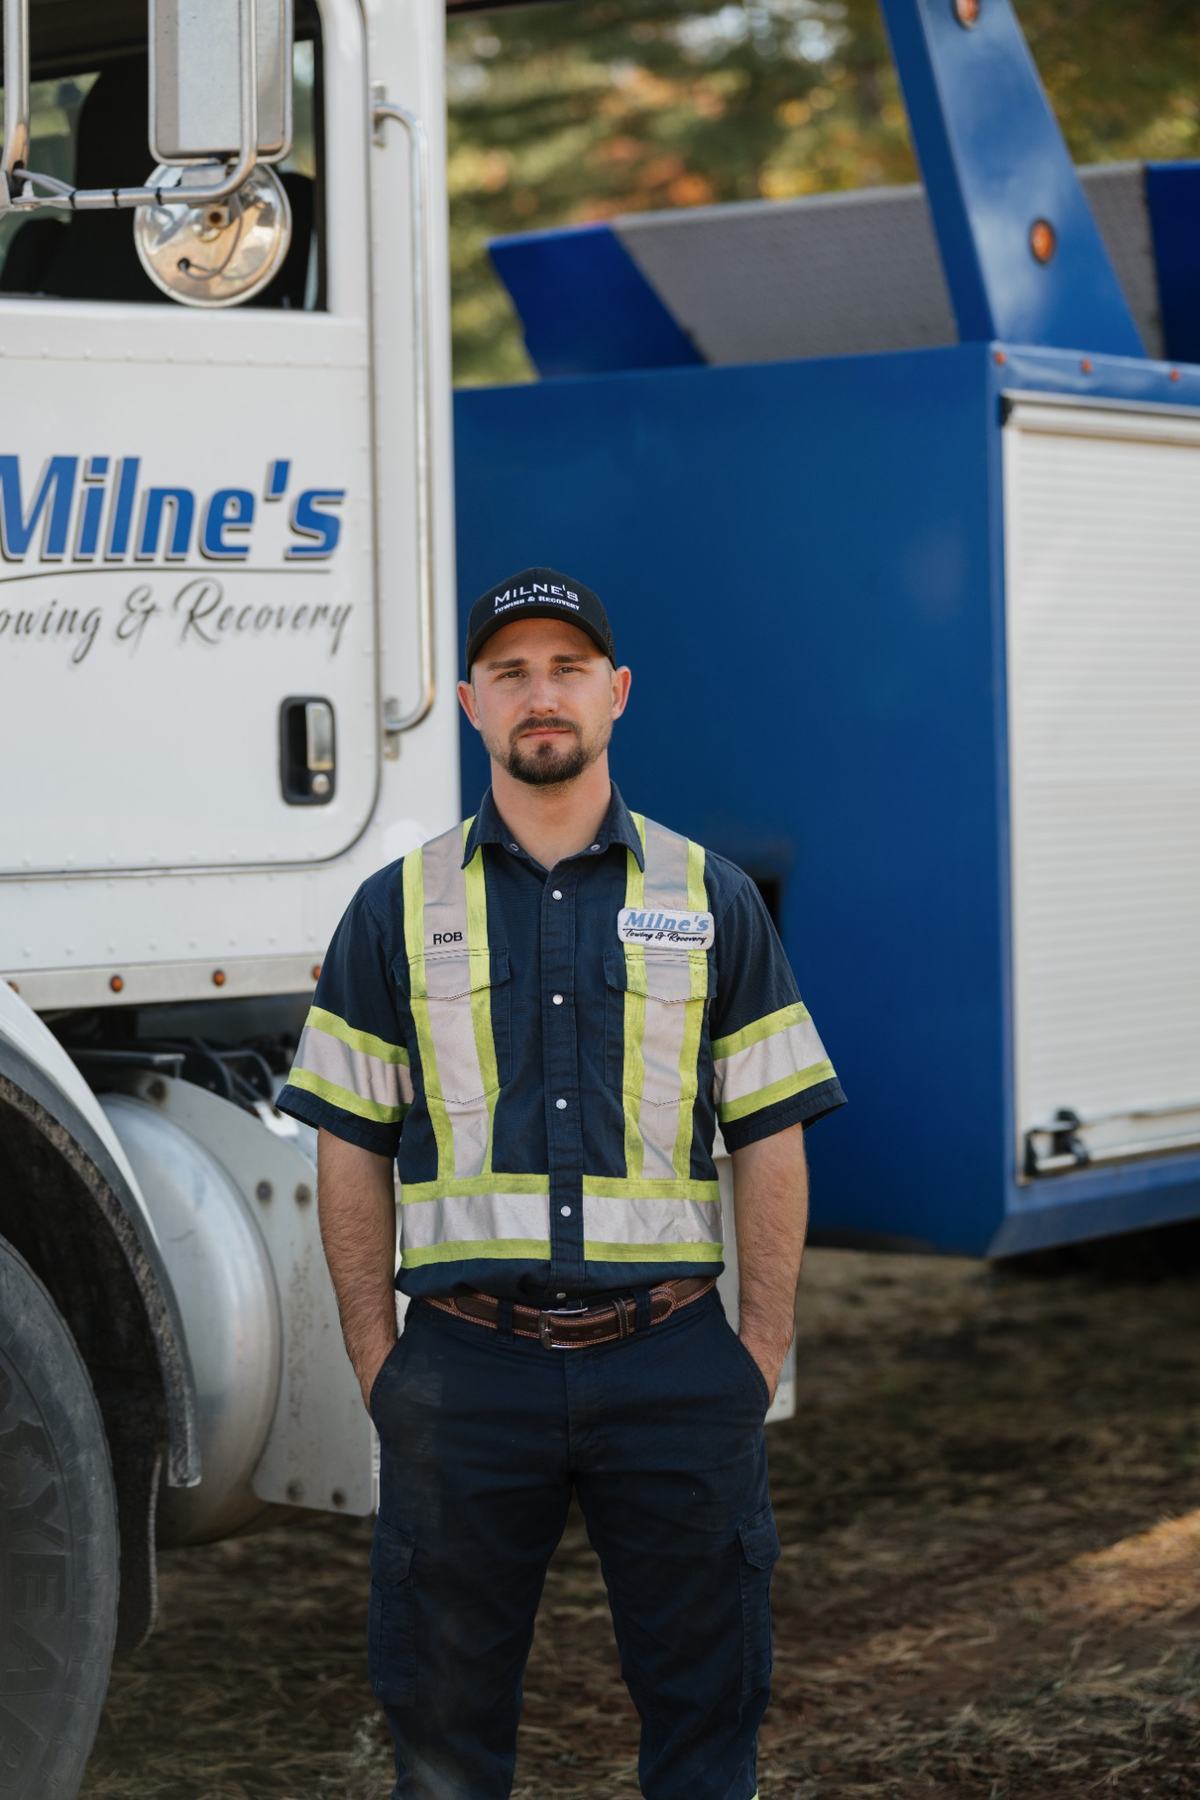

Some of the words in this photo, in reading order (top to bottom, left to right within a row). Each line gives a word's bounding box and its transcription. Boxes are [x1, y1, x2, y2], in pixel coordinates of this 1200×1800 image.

[0, 455, 347, 563] Milne's
[494, 583, 579, 607] MILNE'S
[0, 600, 103, 664] owing
[115, 583, 157, 650] &
[174, 577, 353, 656] Recovery
[624, 912, 710, 932] Milne's
[432, 931, 464, 945] ROB
[624, 930, 654, 941] Towing
[667, 932, 708, 945] Recovery
